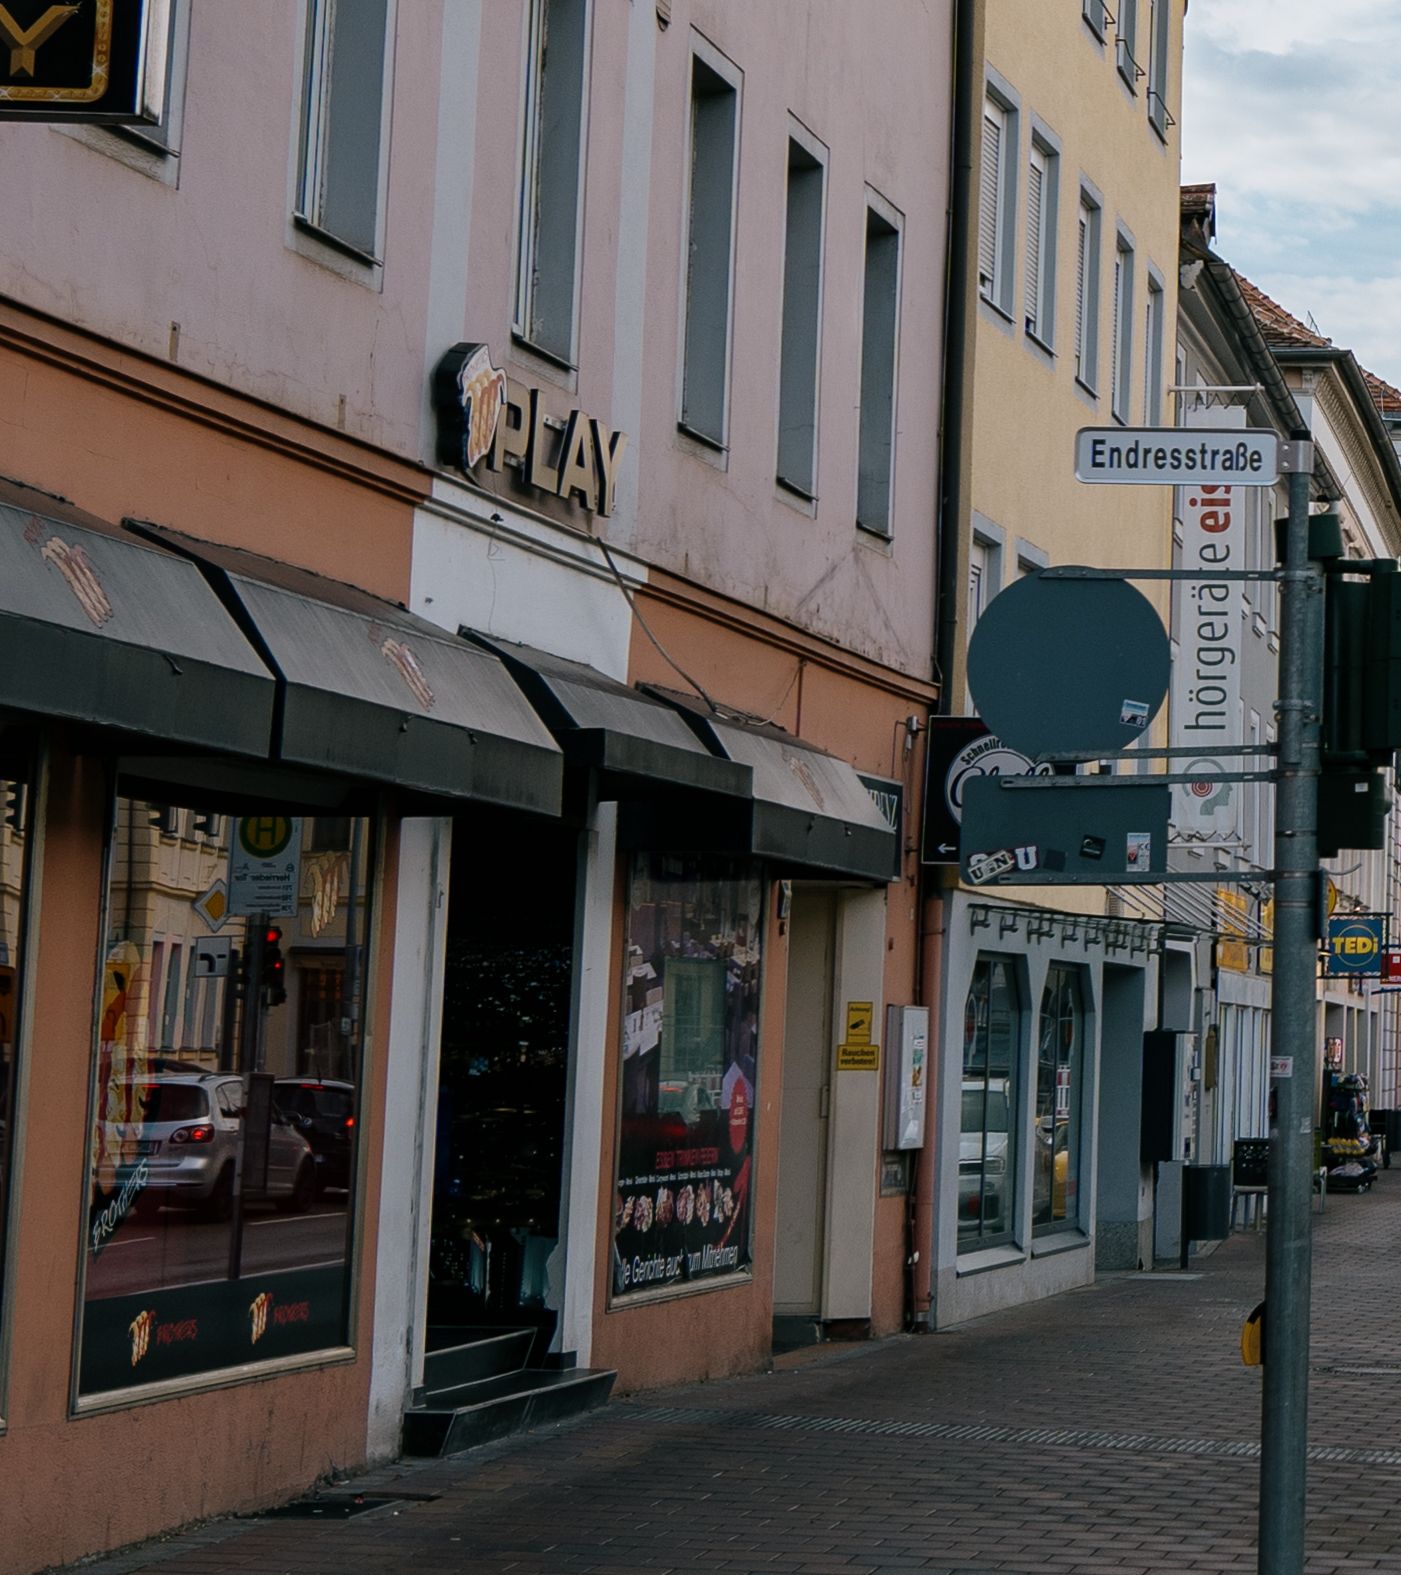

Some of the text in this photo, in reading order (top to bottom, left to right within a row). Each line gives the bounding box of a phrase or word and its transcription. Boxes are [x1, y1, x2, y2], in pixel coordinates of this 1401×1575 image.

[487, 376, 629, 518] PLAY
[1091, 438, 1264, 472] Endresstraße
[1184, 542, 1236, 730] hörgeräe
[1332, 936, 1379, 955] TEDi
[842, 1048, 875, 1056] Rauchen
[632, 1250, 666, 1284] Gerichte
